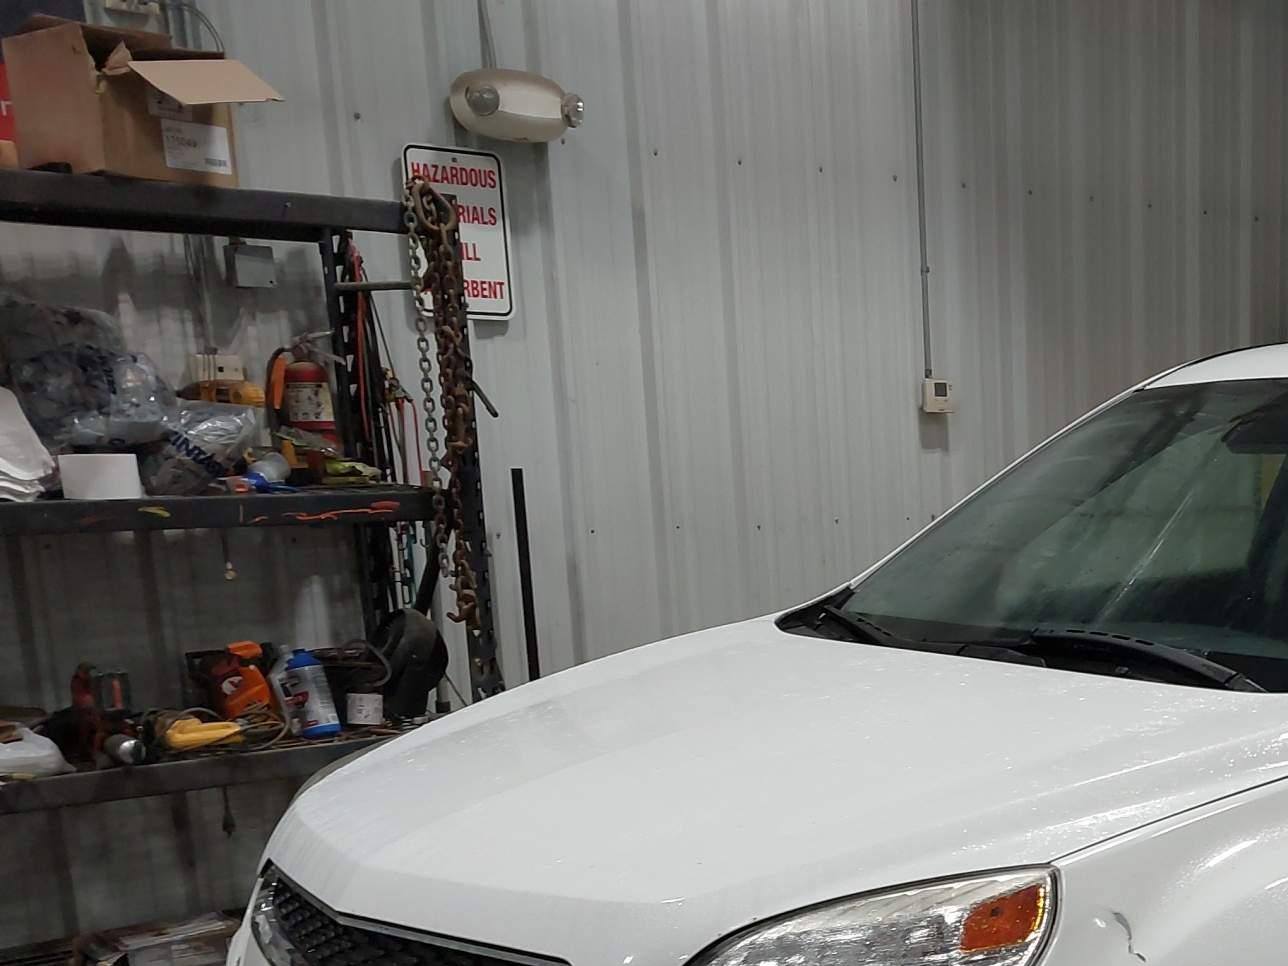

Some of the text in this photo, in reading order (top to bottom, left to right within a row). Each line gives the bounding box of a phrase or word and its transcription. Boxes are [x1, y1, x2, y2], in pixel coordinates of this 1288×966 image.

[411, 162, 496, 188] HAZARDOUS
[456, 204, 497, 226] RIALS
[459, 242, 481, 261] ILL
[463, 279, 504, 299] RBENT
